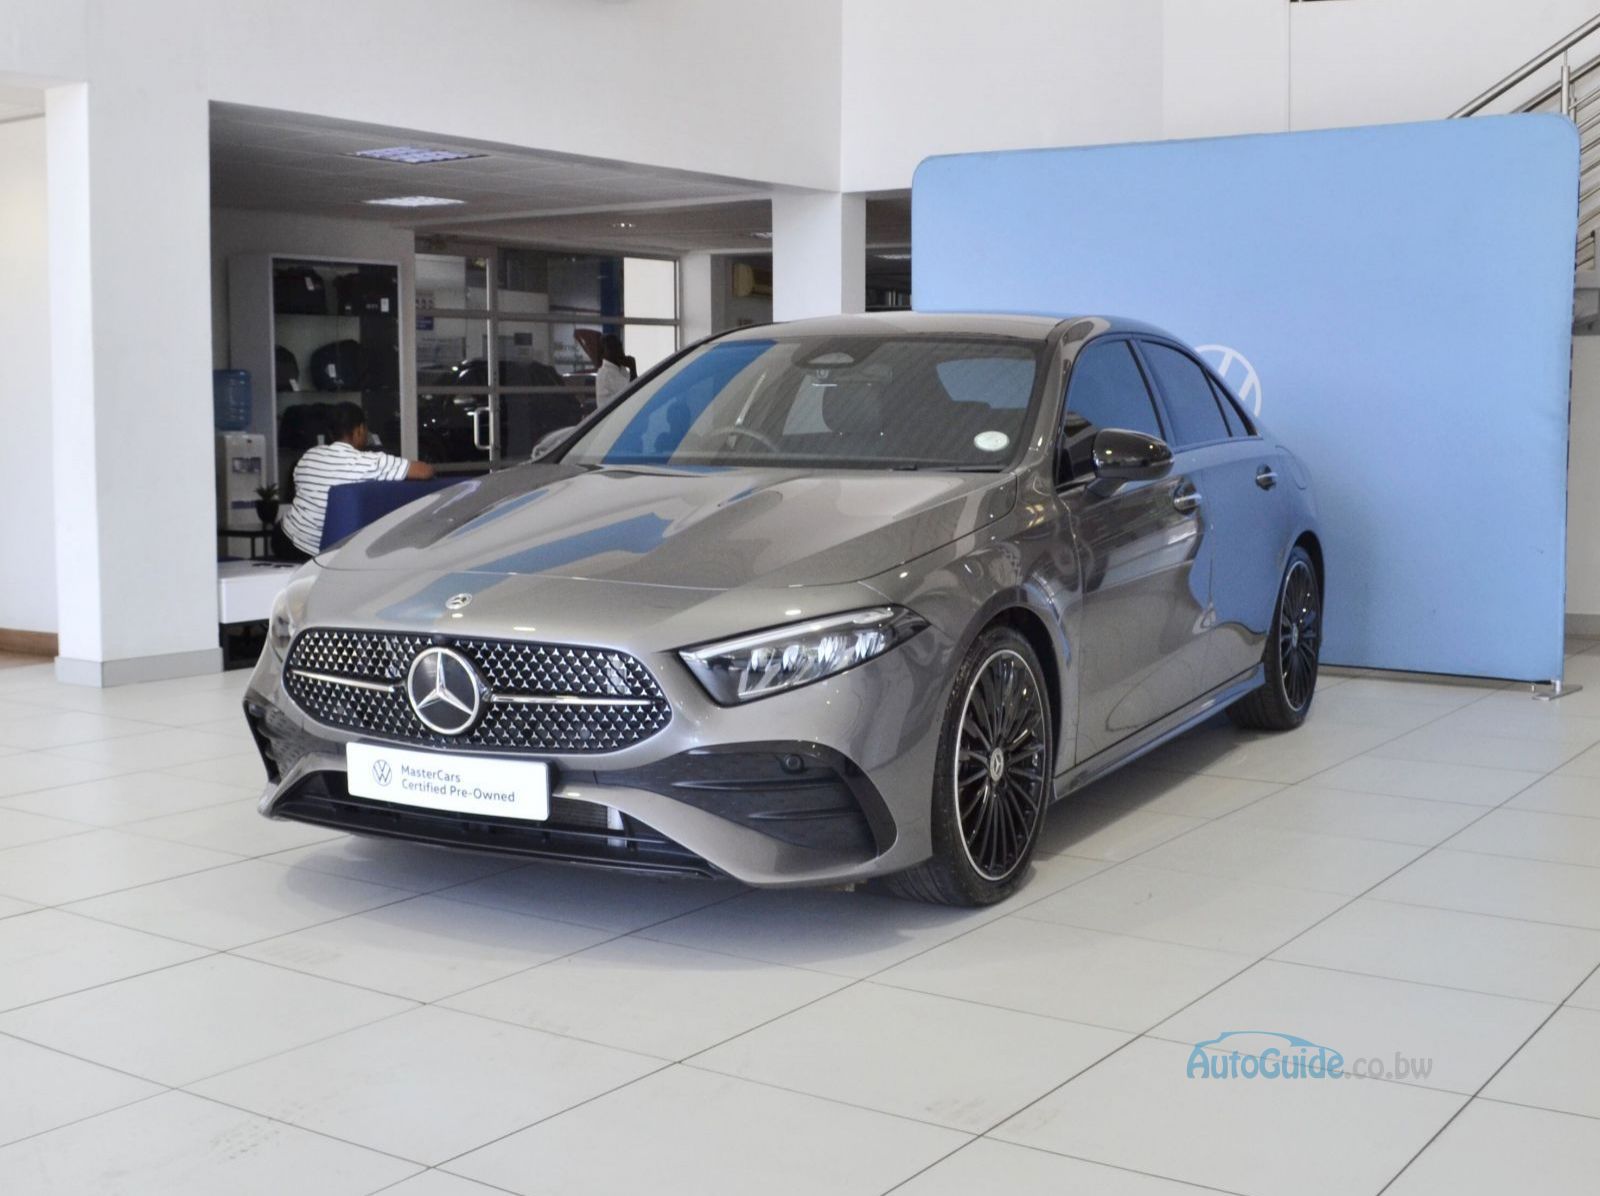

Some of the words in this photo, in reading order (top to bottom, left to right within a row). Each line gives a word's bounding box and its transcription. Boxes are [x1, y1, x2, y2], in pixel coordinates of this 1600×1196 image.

[401, 764, 461, 783] MasterCars
[401, 778, 447, 796] Certified
[449, 785, 516, 803] Pre-Owned
